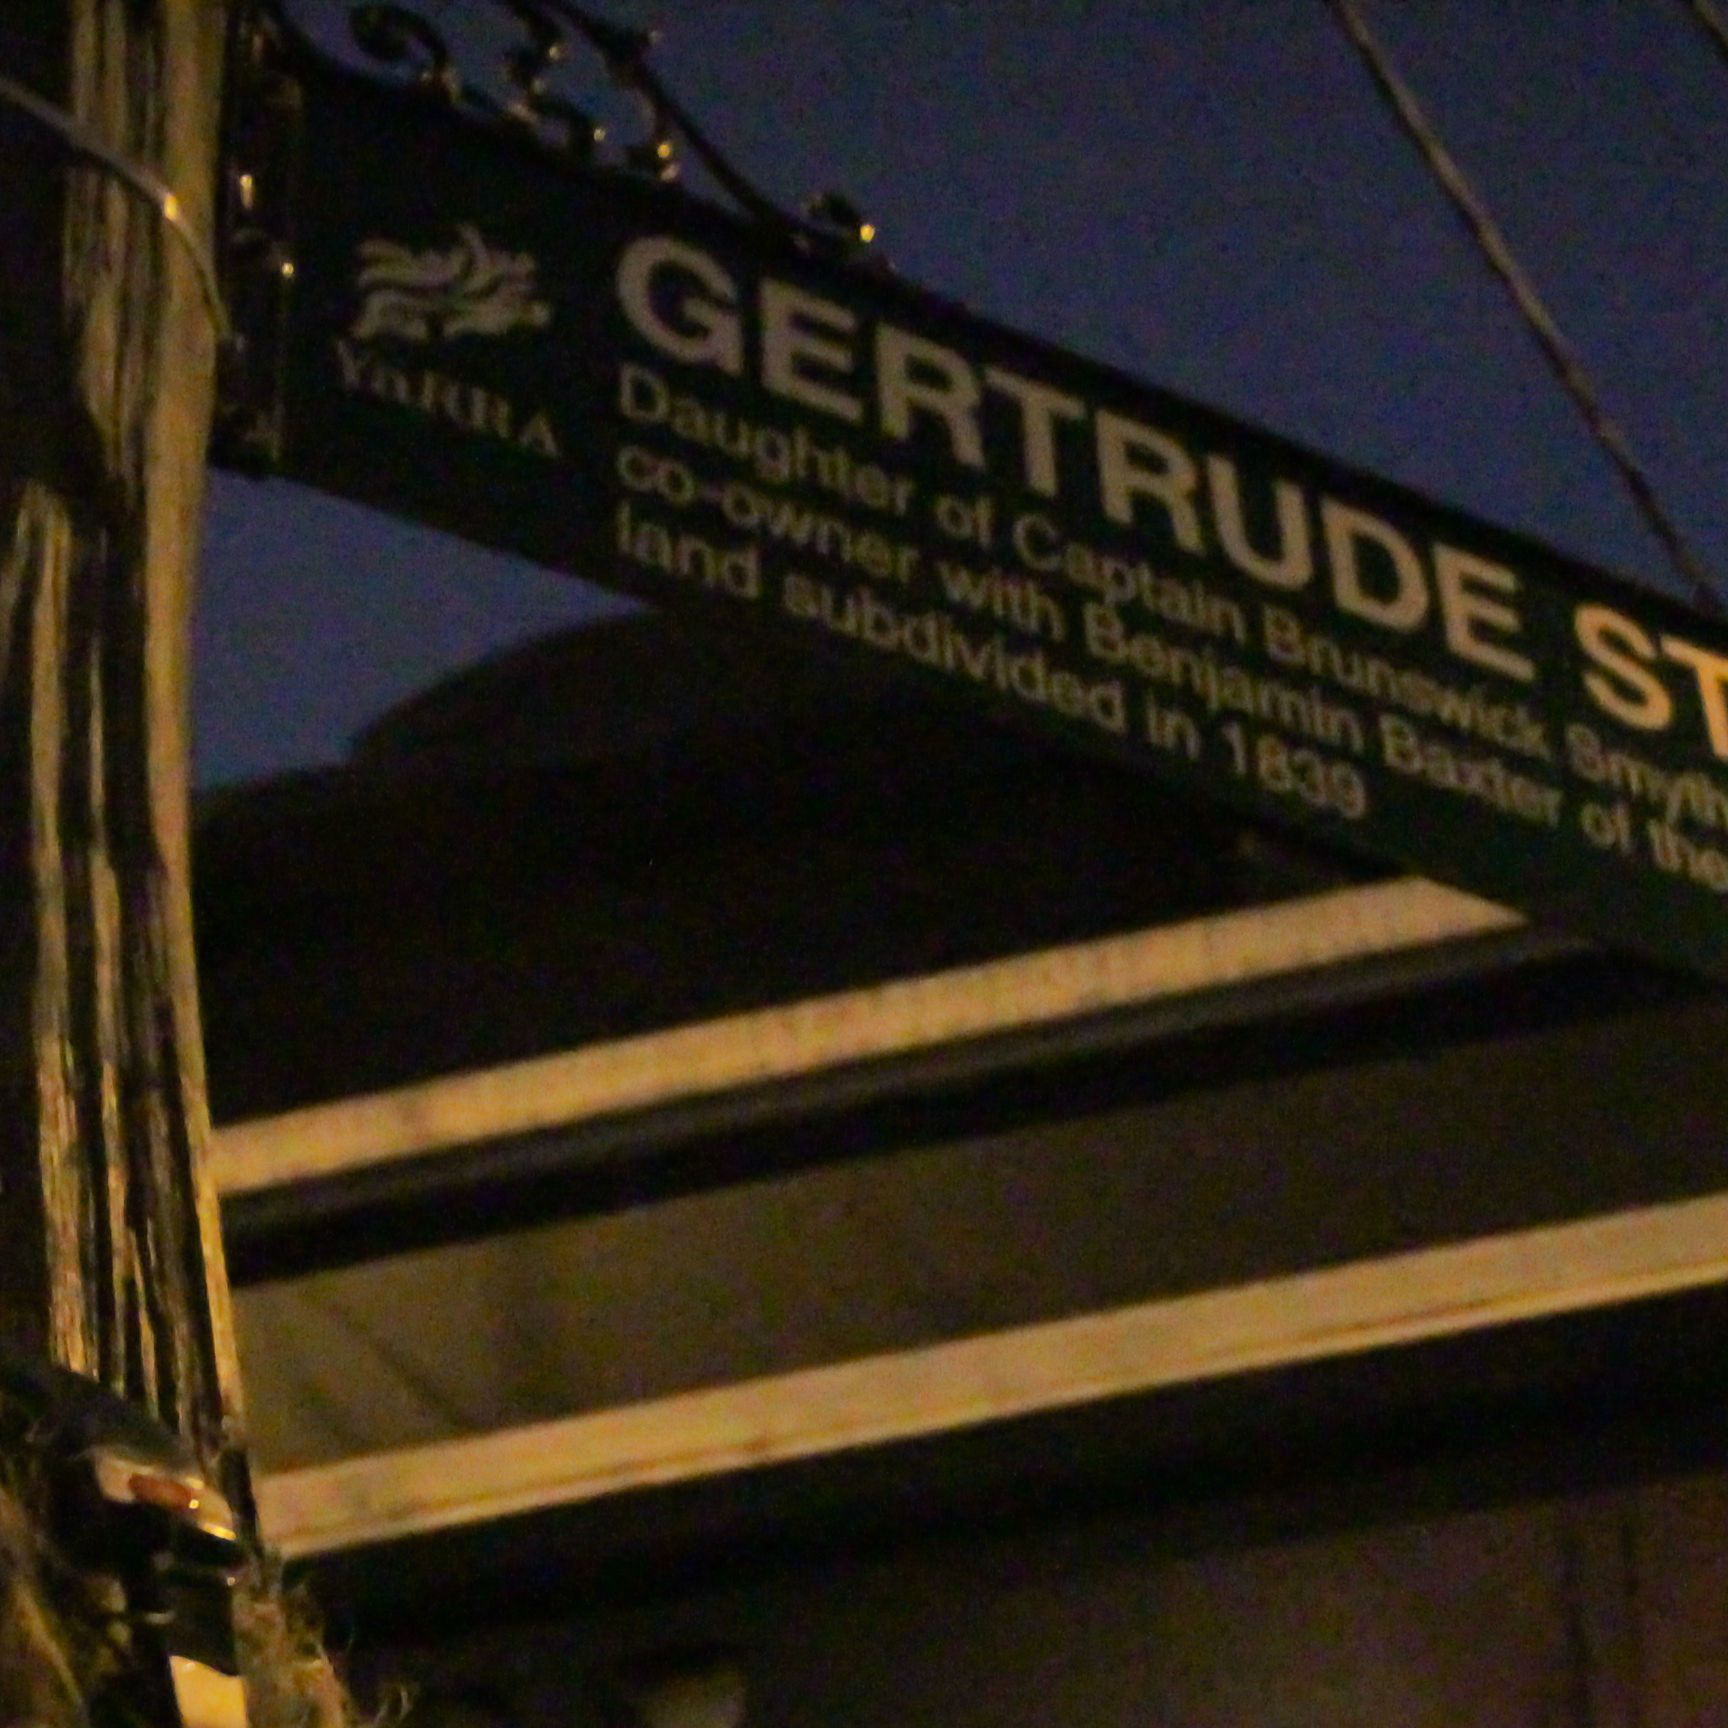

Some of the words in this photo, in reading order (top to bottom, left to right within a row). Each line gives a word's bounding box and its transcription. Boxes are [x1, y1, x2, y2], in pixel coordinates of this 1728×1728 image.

[615, 234, 1535, 683] GERTRUDE
[615, 444, 920, 584] co-owner
[935, 560, 1066, 642] with
[1083, 601, 1366, 757] Benjamin
[1378, 711, 1567, 828] Baxter
[1579, 799, 1634, 857] of
[615, 500, 762, 600] land
[782, 572, 1128, 734] subdivided
[1143, 693, 1202, 760] in
[1219, 718, 1368, 820] 1839
[620, 360, 917, 516] Daughter
[935, 494, 997, 550] of
[1012, 513, 1248, 644] Captain
[1263, 603, 1553, 760] Brunswick
